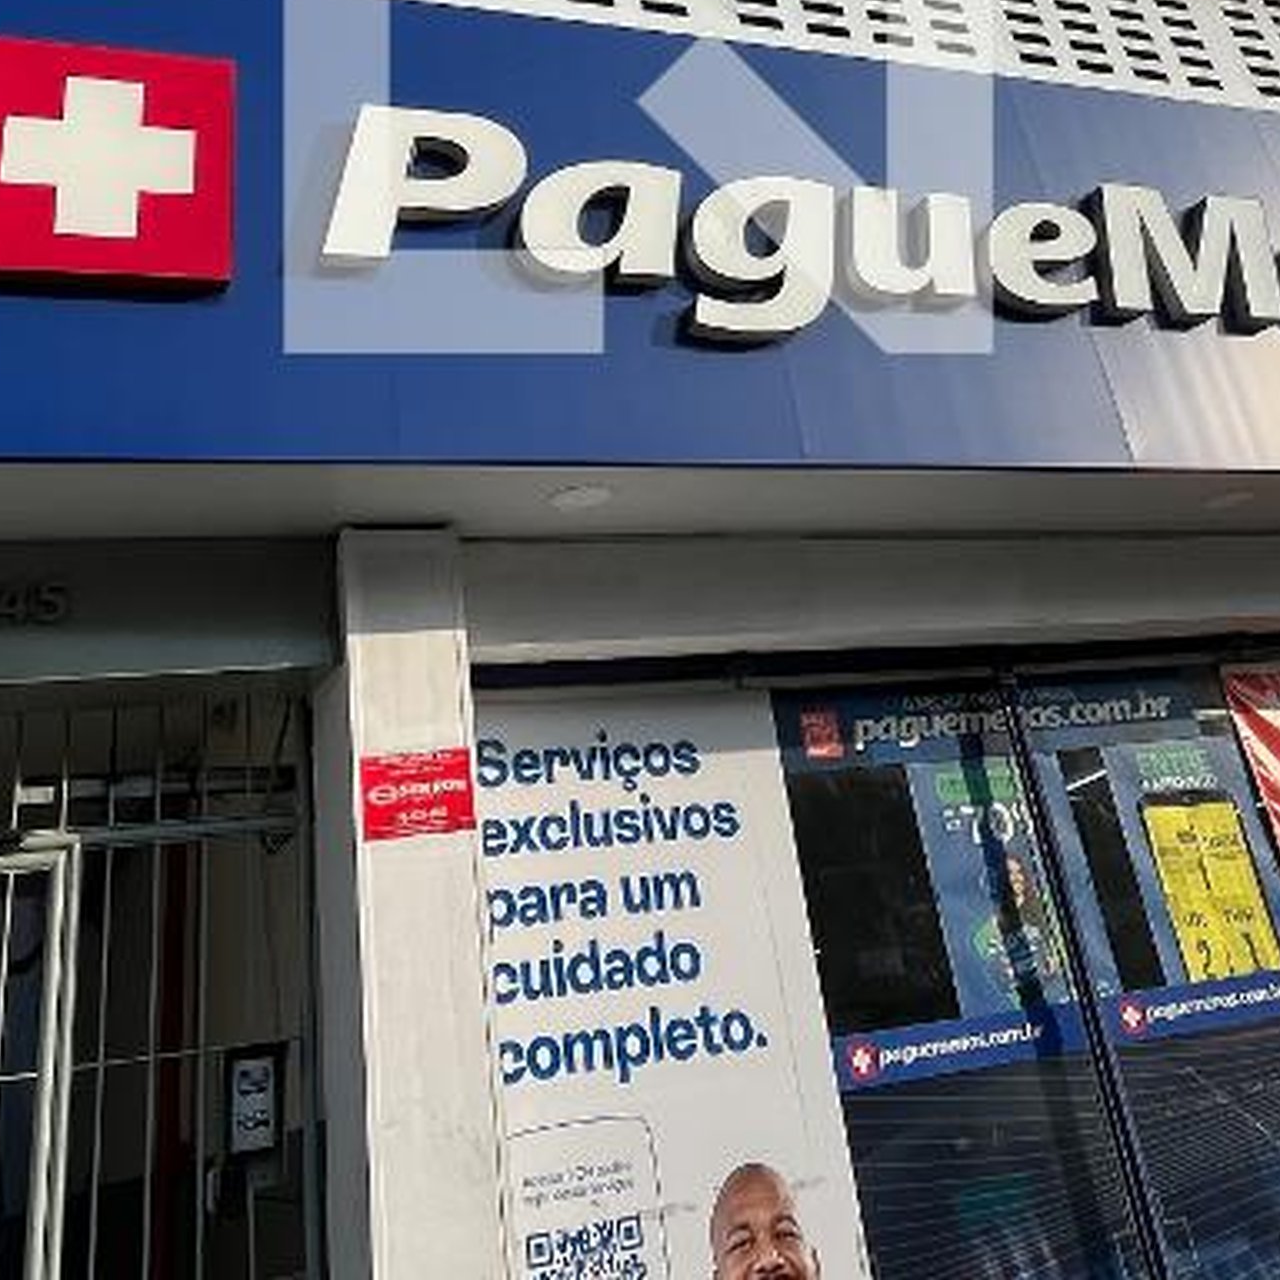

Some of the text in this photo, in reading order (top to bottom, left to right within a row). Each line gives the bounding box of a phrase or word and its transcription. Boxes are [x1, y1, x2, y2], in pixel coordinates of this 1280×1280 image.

[475, 727, 701, 793] Serviços
[481, 792, 741, 857] exclusivos
[487, 869, 701, 944] para um
[492, 929, 701, 1004] cuidado
[499, 1006, 768, 1084] completo.
